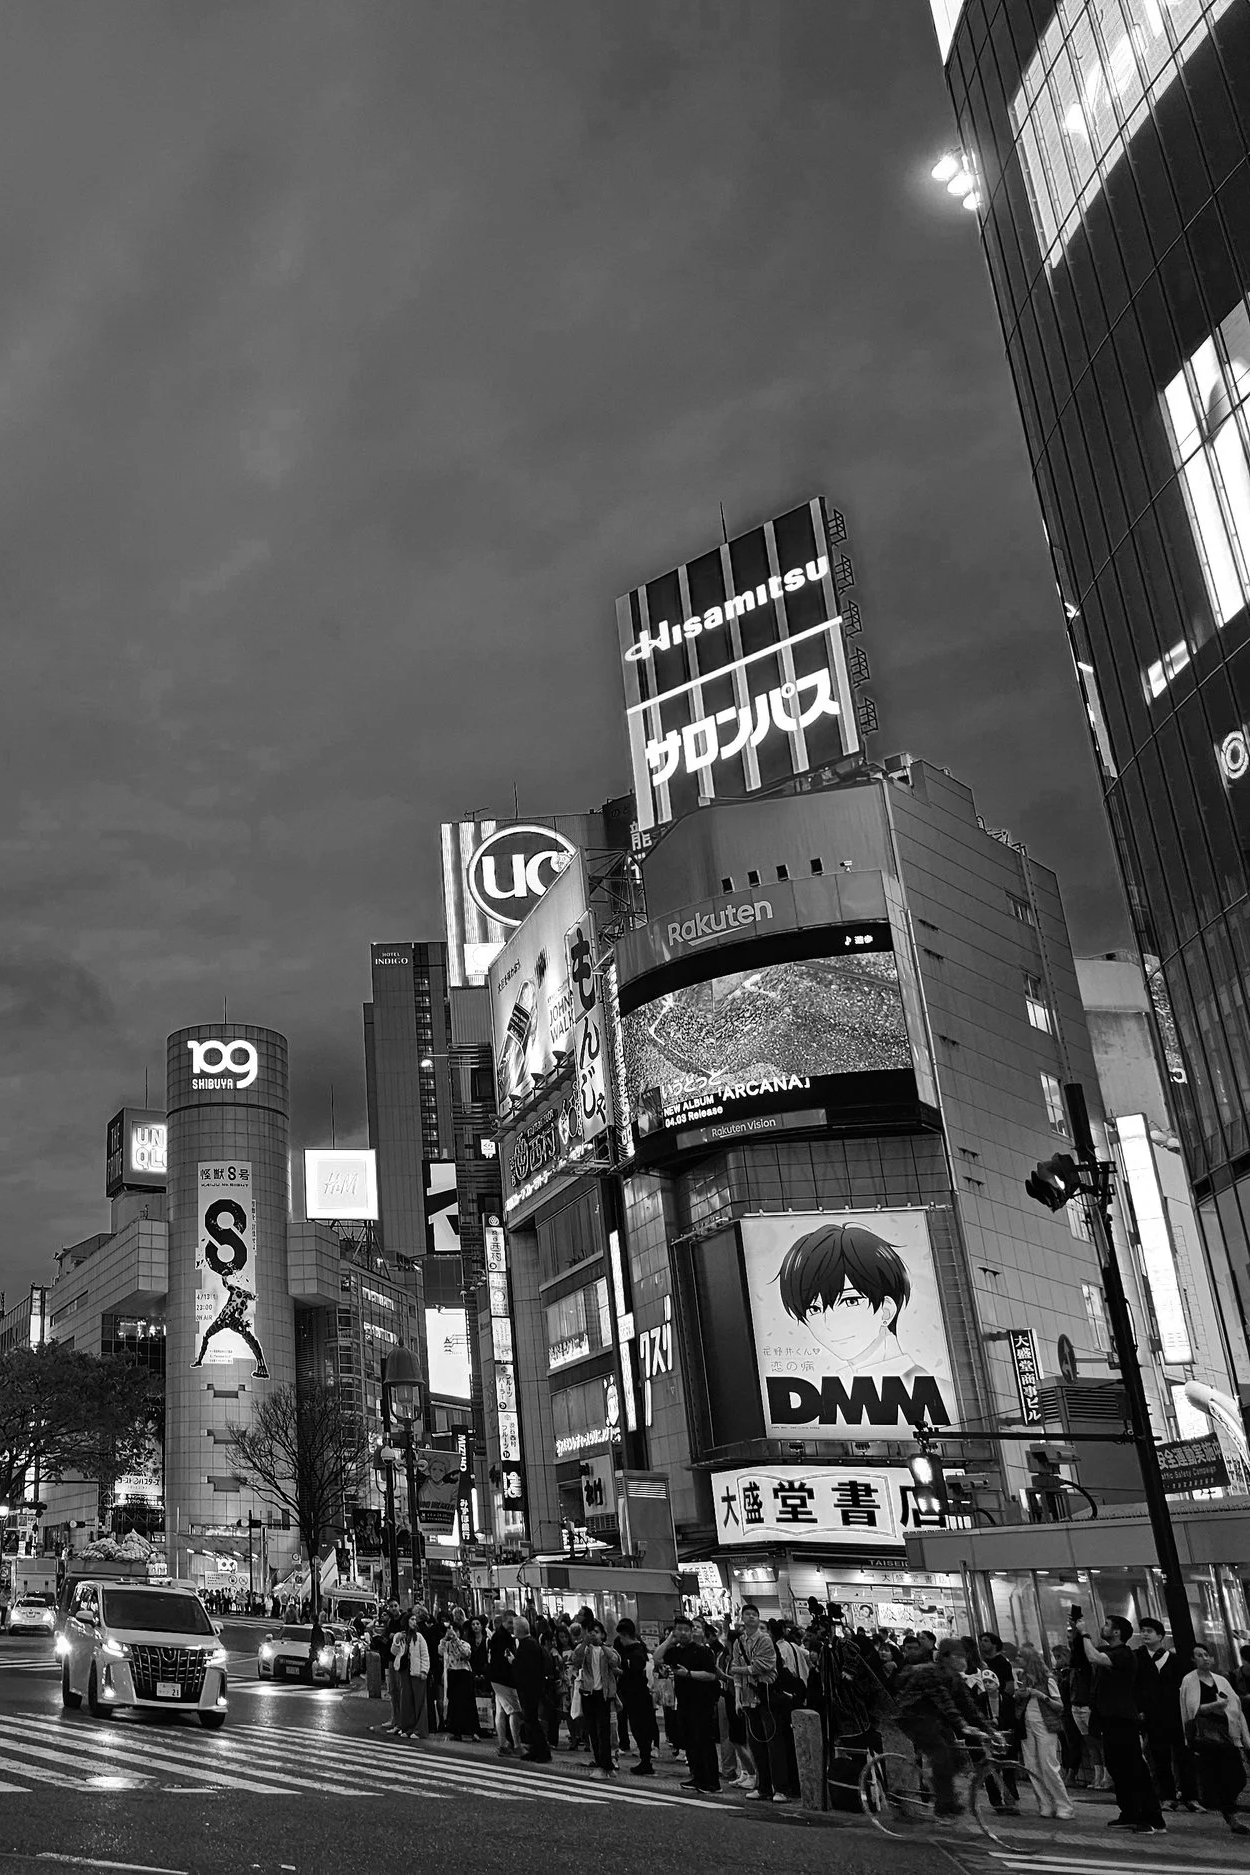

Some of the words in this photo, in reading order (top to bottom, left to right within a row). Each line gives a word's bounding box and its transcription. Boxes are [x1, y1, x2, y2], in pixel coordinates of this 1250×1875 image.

[625, 555, 829, 661] Hisamitsu
[645, 667, 841, 786] サロンパス
[667, 900, 774, 946] Rakuten
[374, 957, 409, 966] INDIGO
[571, 927, 608, 1125] もんじゃ
[187, 1039, 258, 1090] 109
[192, 1078, 234, 1090] SHIBUYA
[663, 1103, 681, 1118] NEW
[683, 1095, 715, 1112] ALBUM
[664, 1114, 687, 1129] 04.03
[688, 1106, 724, 1121] Release
[711, 1122, 746, 1138] Rakuten
[747, 1117, 776, 1131] Vision
[765, 1375, 952, 1426] DMM
[1013, 1333, 1043, 1422] 大盛堂商事ビル
